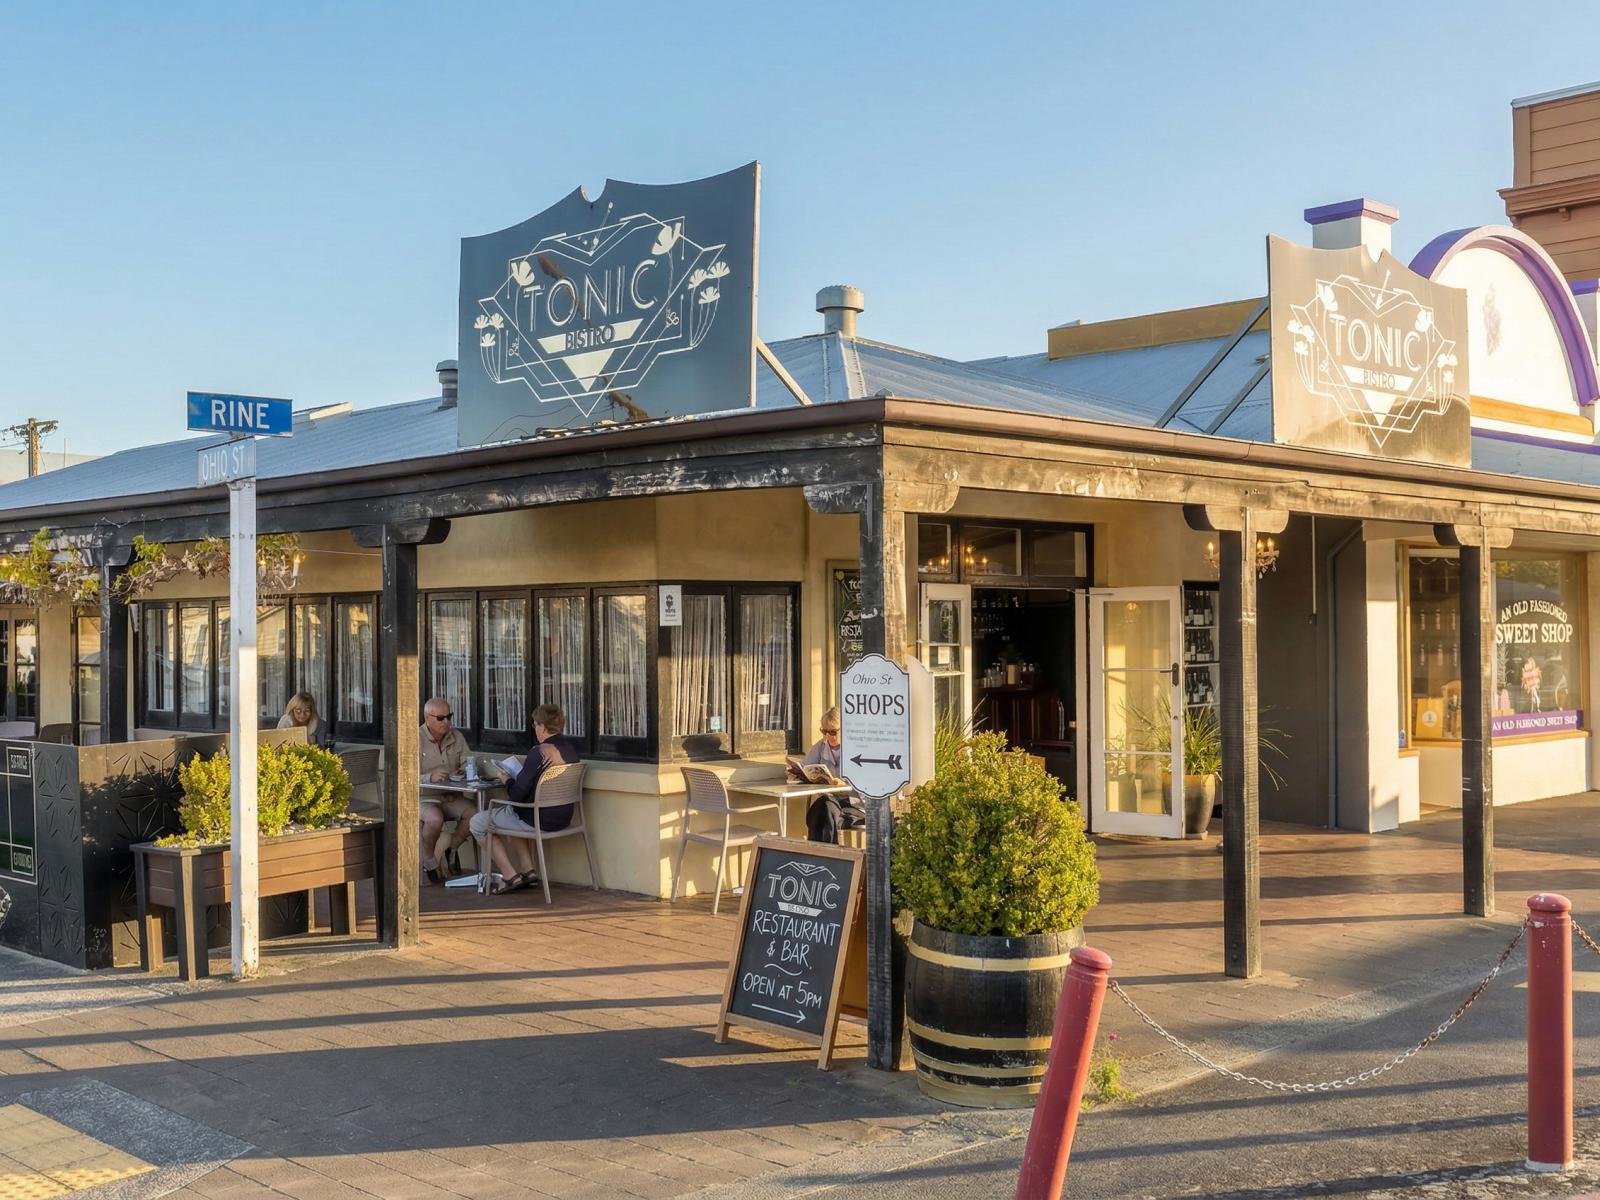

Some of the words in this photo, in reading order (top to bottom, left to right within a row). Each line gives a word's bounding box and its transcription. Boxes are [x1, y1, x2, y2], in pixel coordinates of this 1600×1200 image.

[523, 259, 658, 332] TONIC
[565, 324, 616, 350] BISTRO
[1328, 313, 1422, 372] TONIC
[1363, 368, 1396, 389] BISTRO
[211, 399, 270, 430] RINE
[202, 449, 228, 481] OHIO
[232, 445, 245, 475] ST
[1501, 606, 1512, 623] AN
[1513, 600, 1528, 616] OLD
[1495, 623, 1539, 644] SWEET
[1541, 623, 1574, 643] SHOP
[852, 673, 877, 685] Ohio
[879, 673, 894, 685] St
[845, 693, 905, 716] SHOPS
[768, 873, 840, 909] TONIC
[752, 909, 840, 946] RESTAURANT
[742, 972, 776, 997] OPEN
[778, 984, 794, 1000] AT
[795, 981, 823, 1008] 5PM
